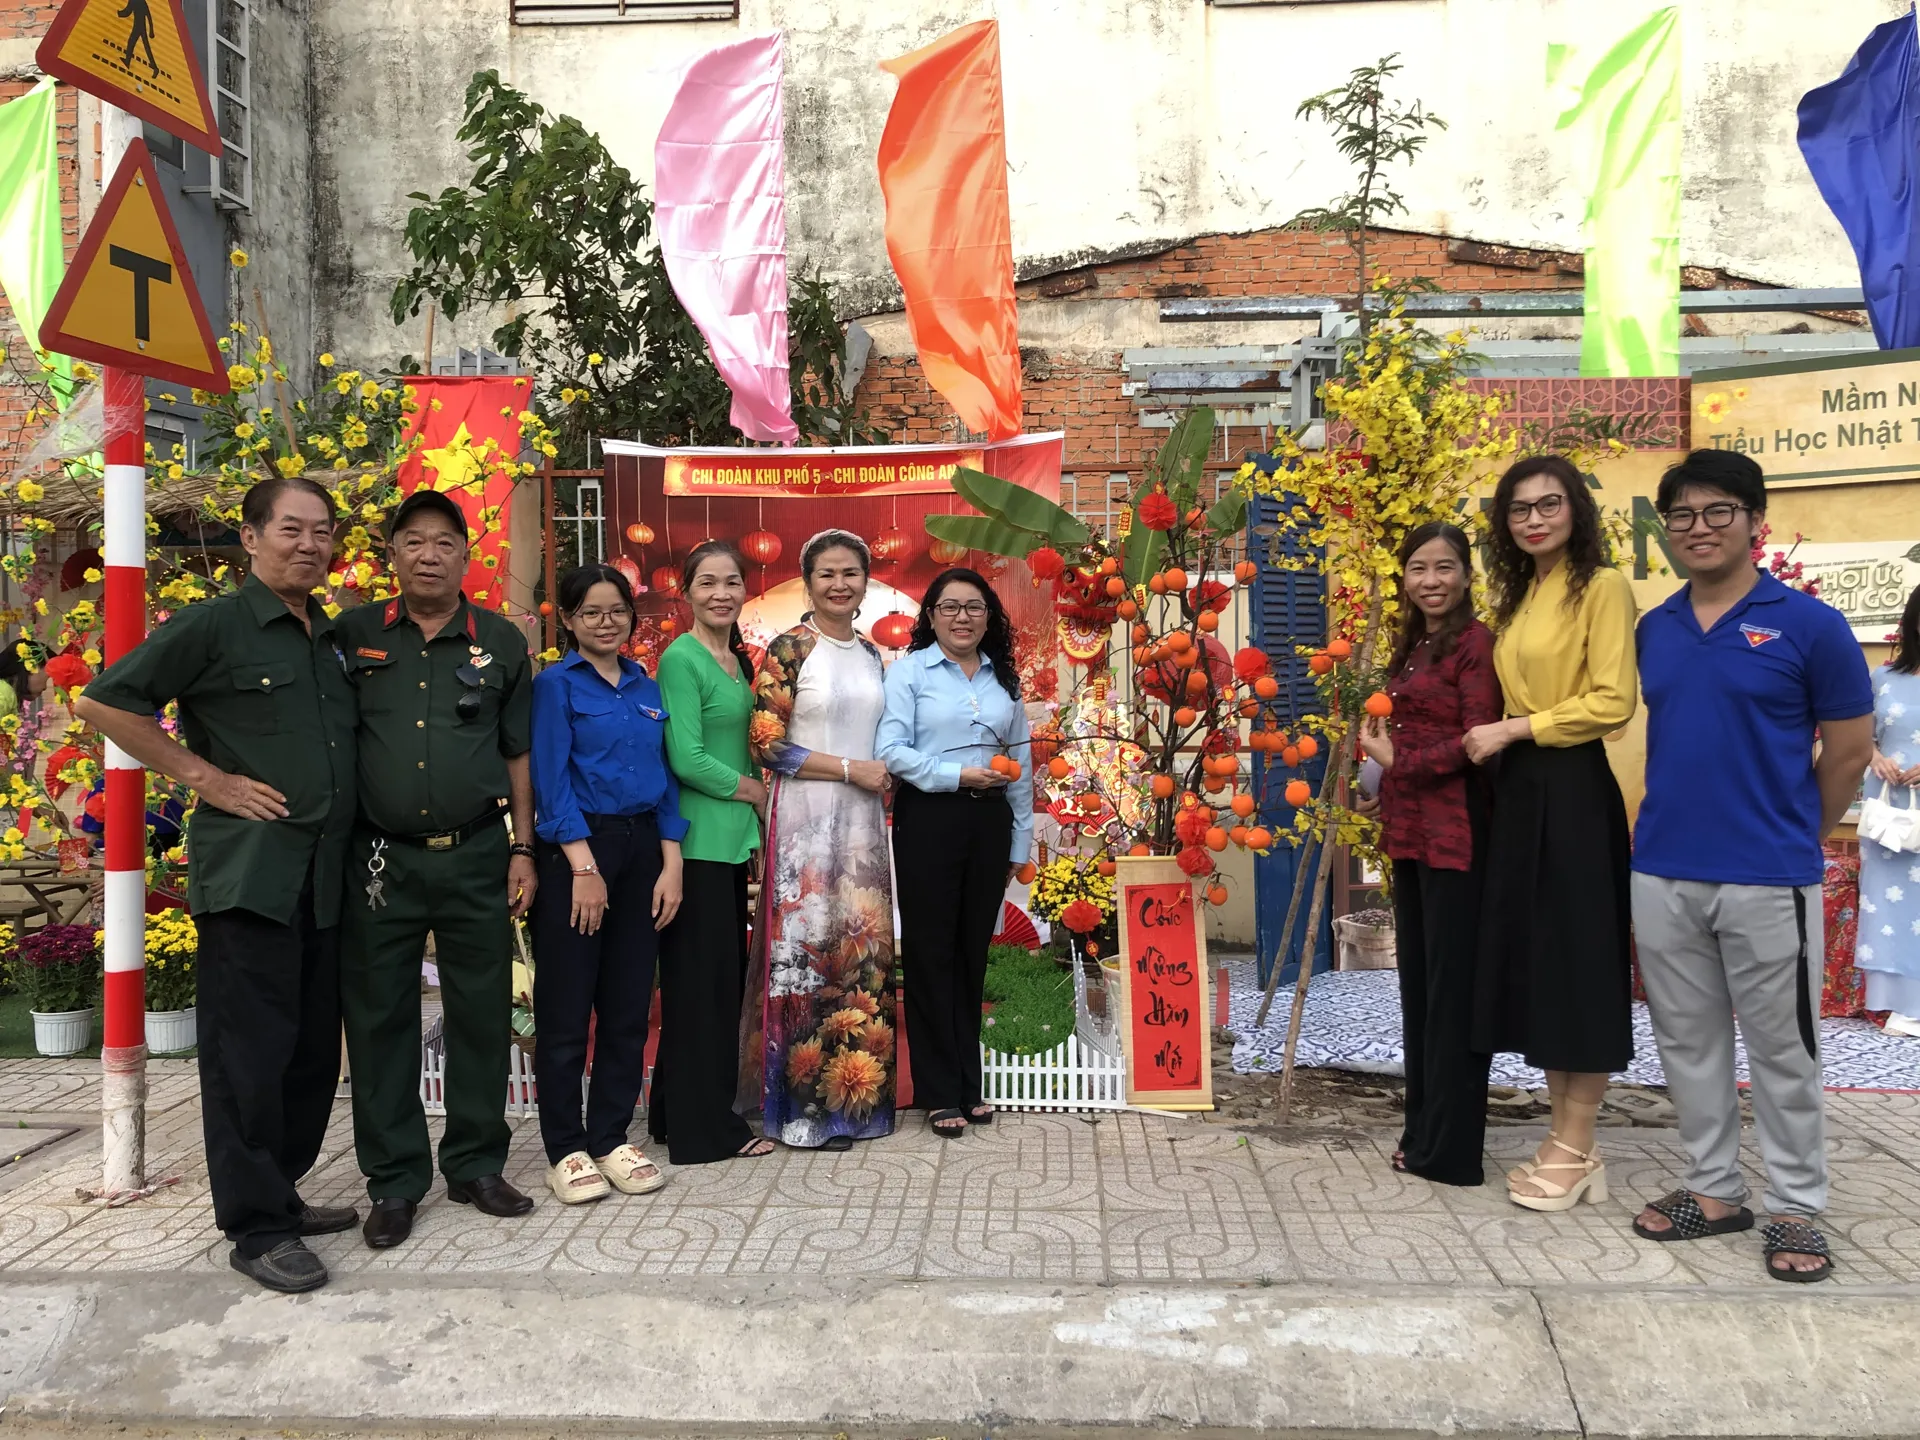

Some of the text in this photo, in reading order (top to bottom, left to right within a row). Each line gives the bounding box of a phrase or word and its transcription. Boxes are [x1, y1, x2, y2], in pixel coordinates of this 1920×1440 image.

[1822, 381, 1920, 413] Mầm N
[1709, 427, 1764, 455] Tiểu
[1774, 428, 1827, 457] Học
[1837, 420, 1902, 450] Nhật
[691, 468, 713, 485] CHI
[716, 465, 752, 485] ĐOÀN
[755, 468, 780, 485] KHU
[784, 462, 809, 485] PHỐ
[813, 468, 821, 484] 5
[833, 467, 856, 484] CHI
[859, 463, 895, 483] ĐOÀN
[899, 462, 935, 482] CÔNG
[938, 464, 958, 480] AN
[1139, 897, 1184, 928] Chúc
[1136, 945, 1194, 986] Mừng
